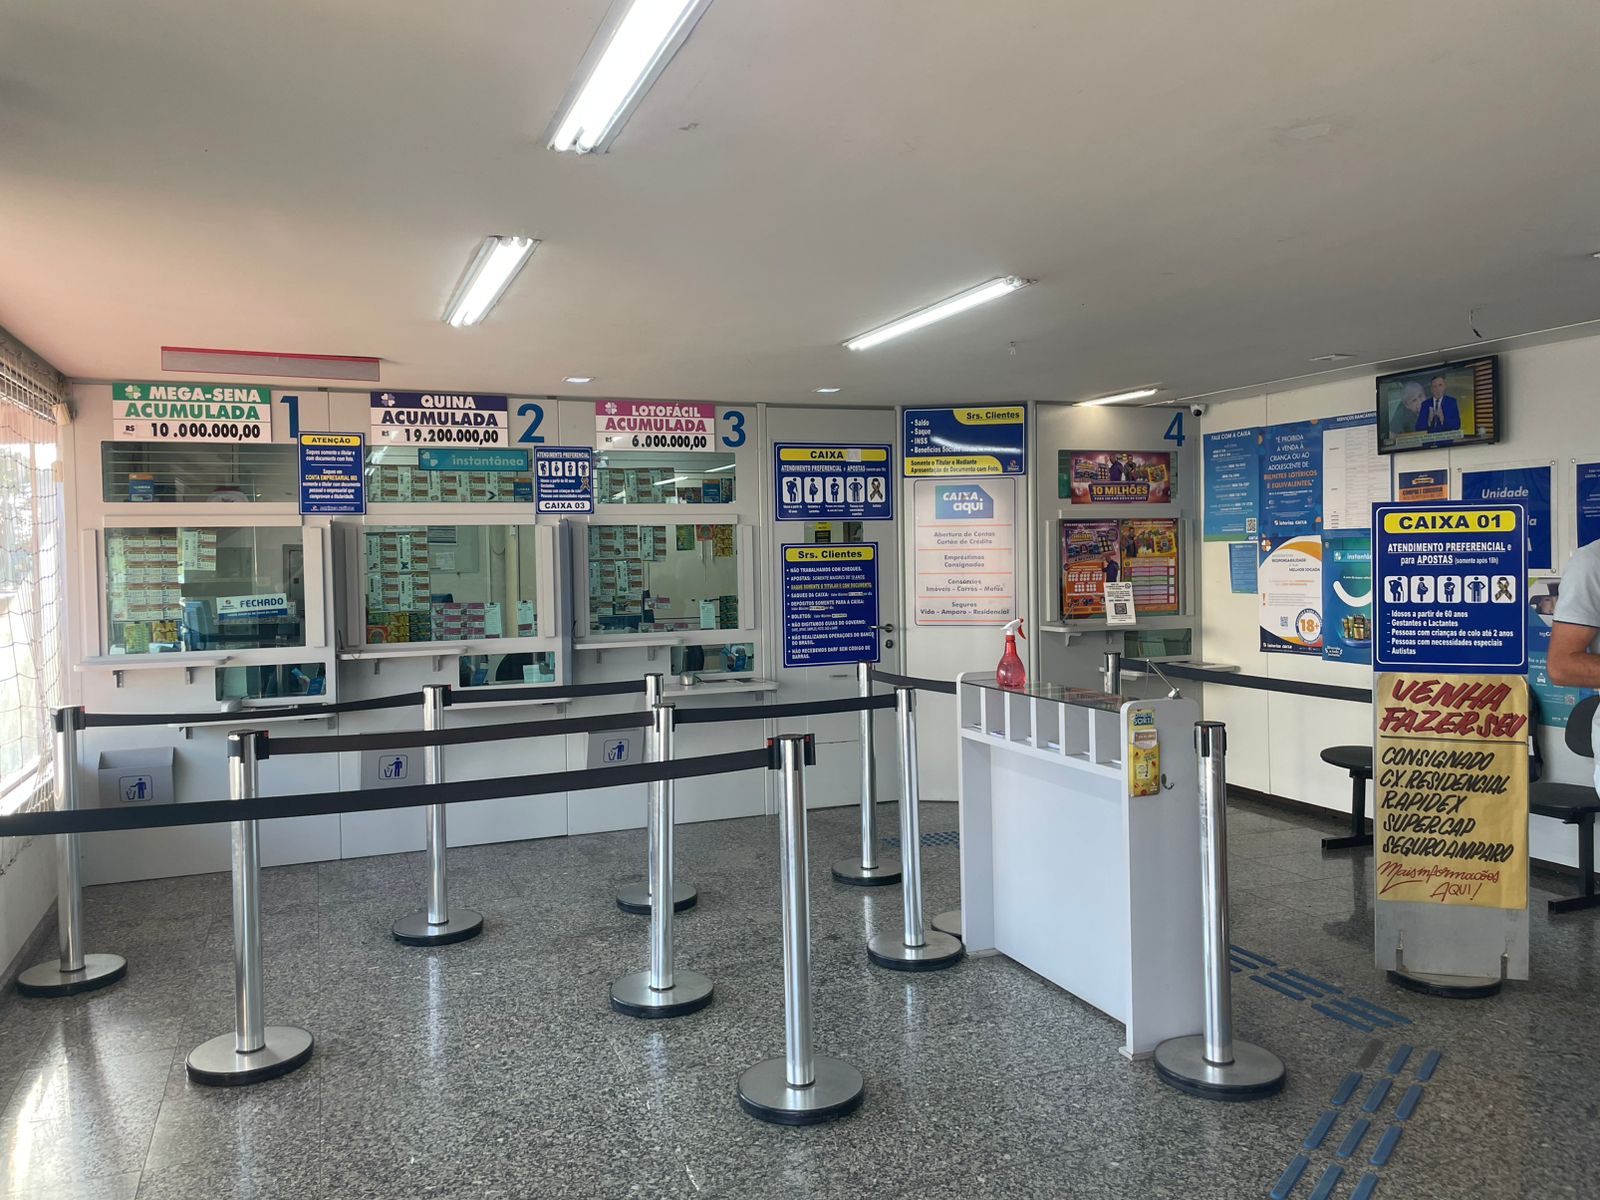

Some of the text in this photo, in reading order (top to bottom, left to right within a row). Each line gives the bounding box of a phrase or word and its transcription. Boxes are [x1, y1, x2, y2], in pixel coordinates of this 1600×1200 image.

[149, 385, 262, 403] MEGA-SENA
[420, 395, 476, 409] QUINA
[125, 402, 261, 420] ACUMULADA
[631, 402, 701, 417] LOTOFÁCIL
[966, 411, 1020, 420] Srs. Clientes
[280, 395, 299, 439] 1
[381, 410, 499, 427] ACUMULADA
[516, 403, 545, 443] 2
[604, 417, 708, 432] ACUMULADA
[721, 410, 747, 448] 3
[1163, 412, 1186, 447] 4
[404, 428, 499, 444] 19.200.000,00
[915, 428, 931, 436] Saque
[1282, 434, 1304, 442] PROIBIDA
[1299, 442, 1304, 450] À
[450, 454, 525, 467] instantânea
[811, 450, 844, 459] CAIXA
[1270, 454, 1291, 462] CRIANÇA
[1268, 462, 1301, 471] ADOLESCENTE
[1289, 470, 1318, 478] LOTÉRICOS
[1093, 484, 1148, 495] 10 MILHÕES
[1481, 486, 1529, 499] Unidade
[943, 491, 979, 501] CAIXA
[953, 497, 983, 514] aqui
[1398, 513, 1501, 530] CAIXA 01
[1388, 542, 1444, 553] ATENDIMENTO
[1446, 541, 1506, 552] PREFERENCIAL
[798, 550, 862, 559] Srs. Clientes
[1401, 556, 1415, 566] para
[1417, 554, 1454, 565] APOSTAS
[1455, 557, 1475, 565] (somente
[241, 597, 284, 608] FECHADO
[942, 608, 967, 617] Amparo
[1392, 610, 1411, 618] Idosos
[1418, 610, 1434, 619] partir
[1300, 618, 1320, 633] 18+
[1392, 619, 1422, 627] Gestantes
[1429, 619, 1458, 627] Lactantes
[1392, 628, 1416, 636] Pessoas
[1432, 629, 1458, 638] crianças
[1468, 629, 1481, 637] colo
[1482, 629, 1492, 637] até
[1493, 629, 1497, 637] 2
[1392, 638, 1416, 646] Pessoas
[1432, 638, 1472, 646] necessidades
[1474, 638, 1503, 647] especiais
[1392, 647, 1417, 655] Autistas
[1391, 678, 1513, 712] VENHA
[1379, 706, 1528, 738] FAZER SEU
[1381, 746, 1496, 772] CONSIGNADO
[1381, 790, 1468, 814] RAPIDEX
